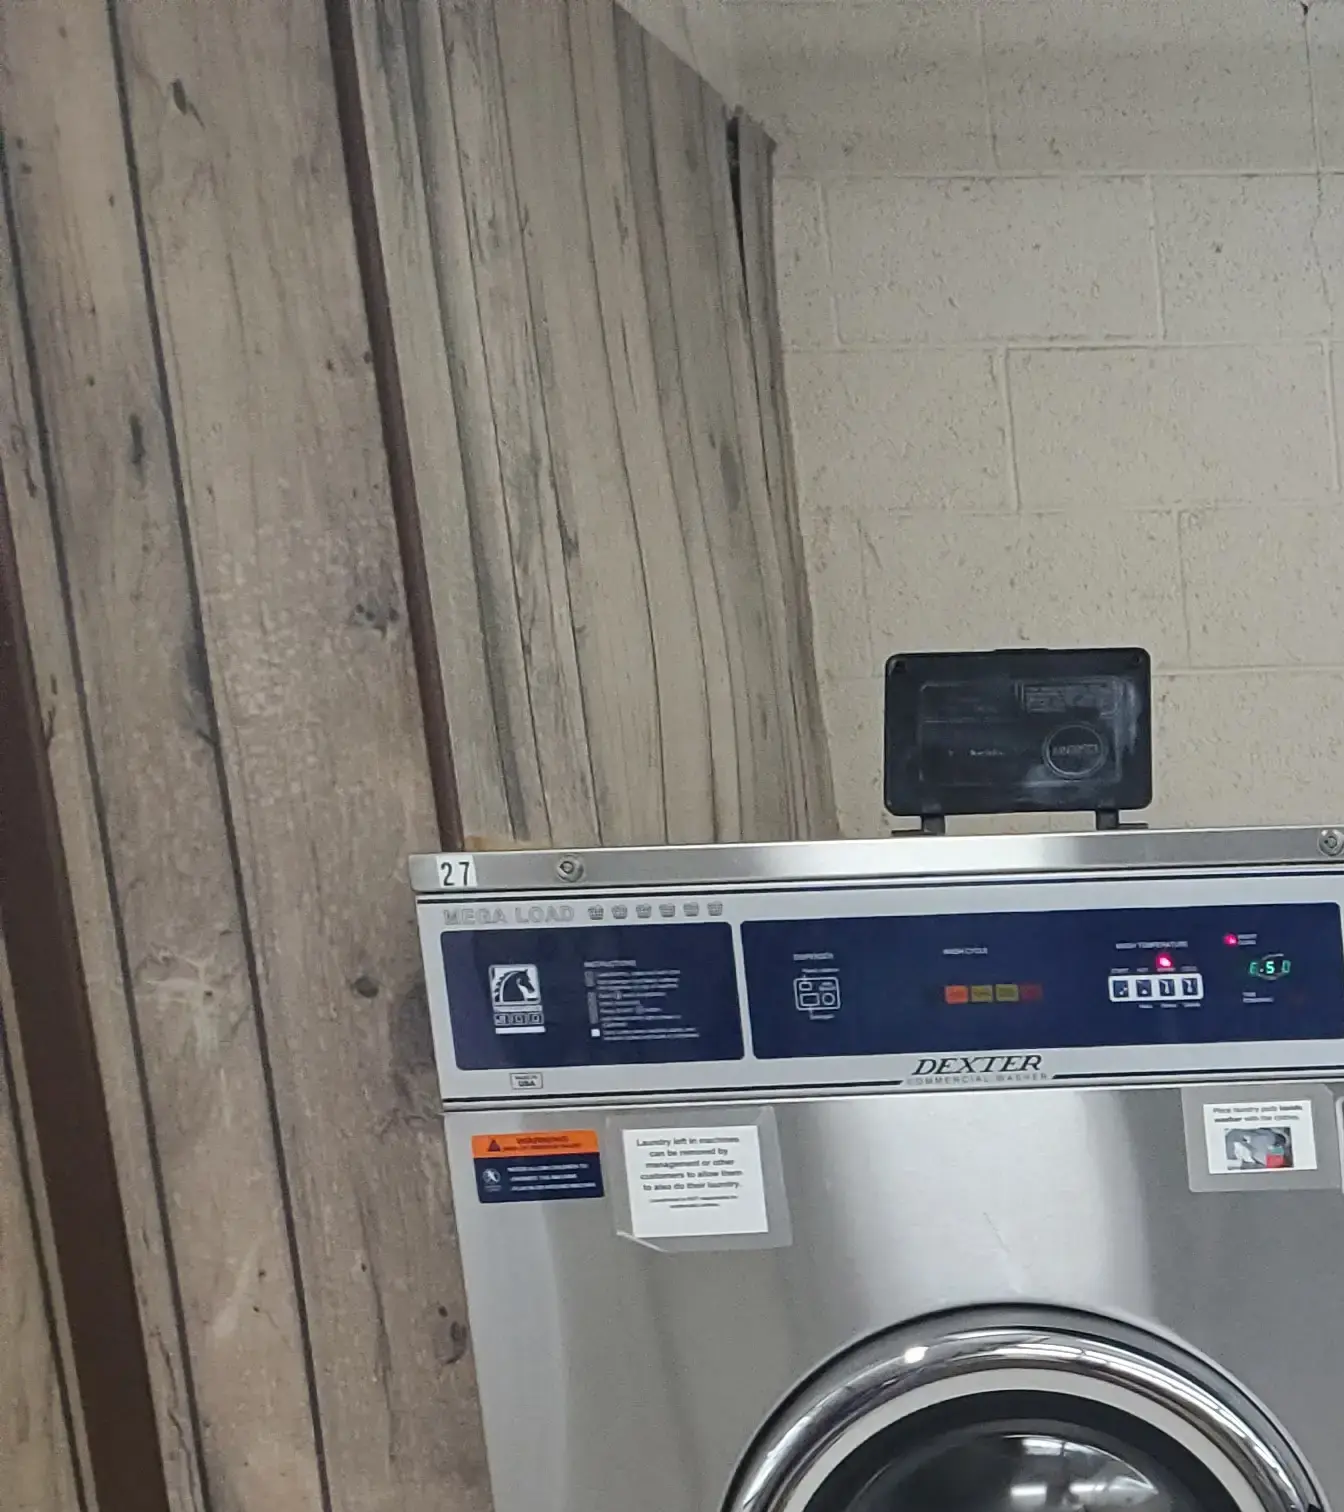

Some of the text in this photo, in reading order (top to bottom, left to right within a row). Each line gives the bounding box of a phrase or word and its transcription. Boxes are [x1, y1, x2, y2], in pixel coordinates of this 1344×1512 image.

[441, 861, 470, 886] 27
[444, 905, 574, 925] MEGA LOAD
[912, 1055, 1042, 1075] DEXTER
[907, 1073, 1047, 1085] COMMERCIAL WASHER
[636, 1138, 671, 1146] Laundry
[643, 1183, 651, 1191] to
